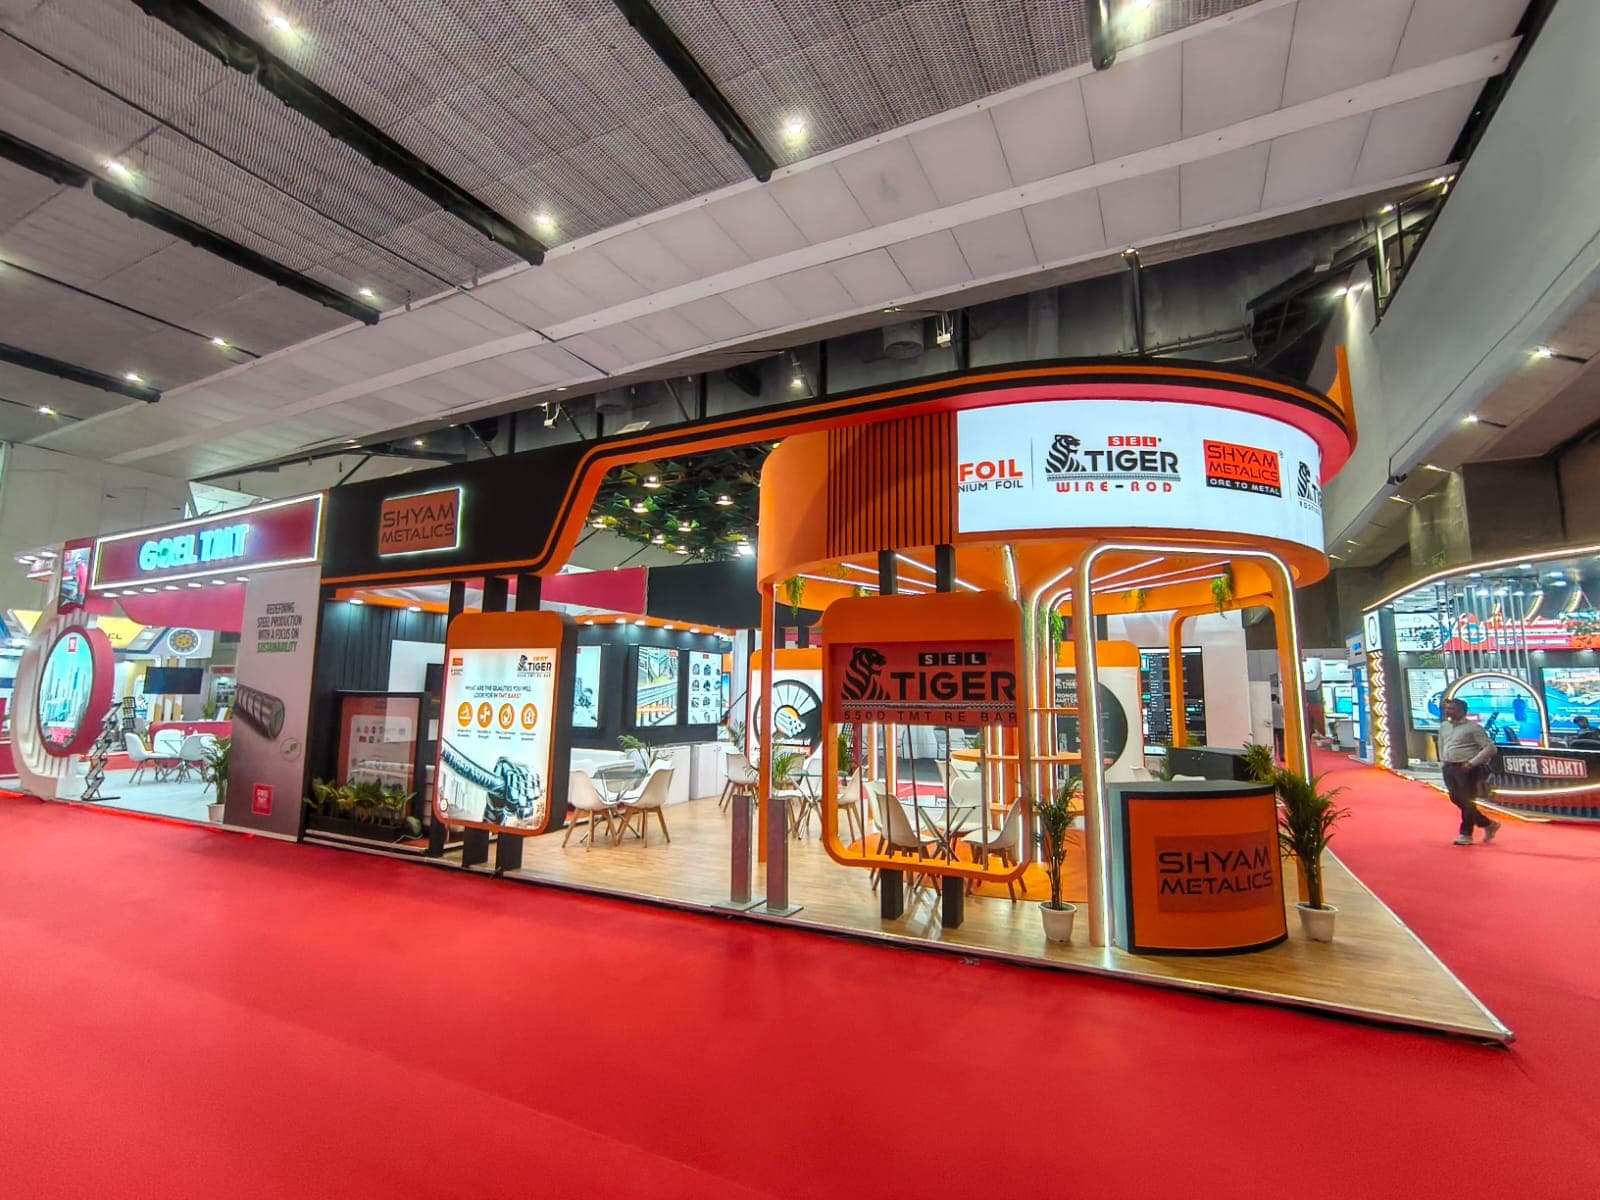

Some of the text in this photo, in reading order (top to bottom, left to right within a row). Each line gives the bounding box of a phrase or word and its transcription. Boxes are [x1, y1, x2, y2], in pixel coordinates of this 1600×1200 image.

[1110, 436, 1155, 447] SEL
[1084, 450, 1179, 473] TIGER
[1207, 445, 1277, 469] SHYAM
[960, 459, 1024, 482] FOIL
[1209, 461, 1279, 482] METALICS
[995, 480, 1024, 490] FOIL
[1210, 478, 1280, 495] ORE TO METAL
[383, 502, 455, 528] SHYAM
[381, 523, 455, 544] METALICS
[257, 615, 303, 628] STEEL PRODUCTION
[528, 662, 552, 672] TIGER
[921, 653, 983, 665] SEL
[890, 671, 1017, 701] TIGER
[844, 711, 1017, 722] 550D TMT RE BAR
[1506, 758, 1584, 775] SUPER SHAKTI
[1158, 846, 1271, 874] SHYAM
[1160, 870, 1273, 895] METALICS
